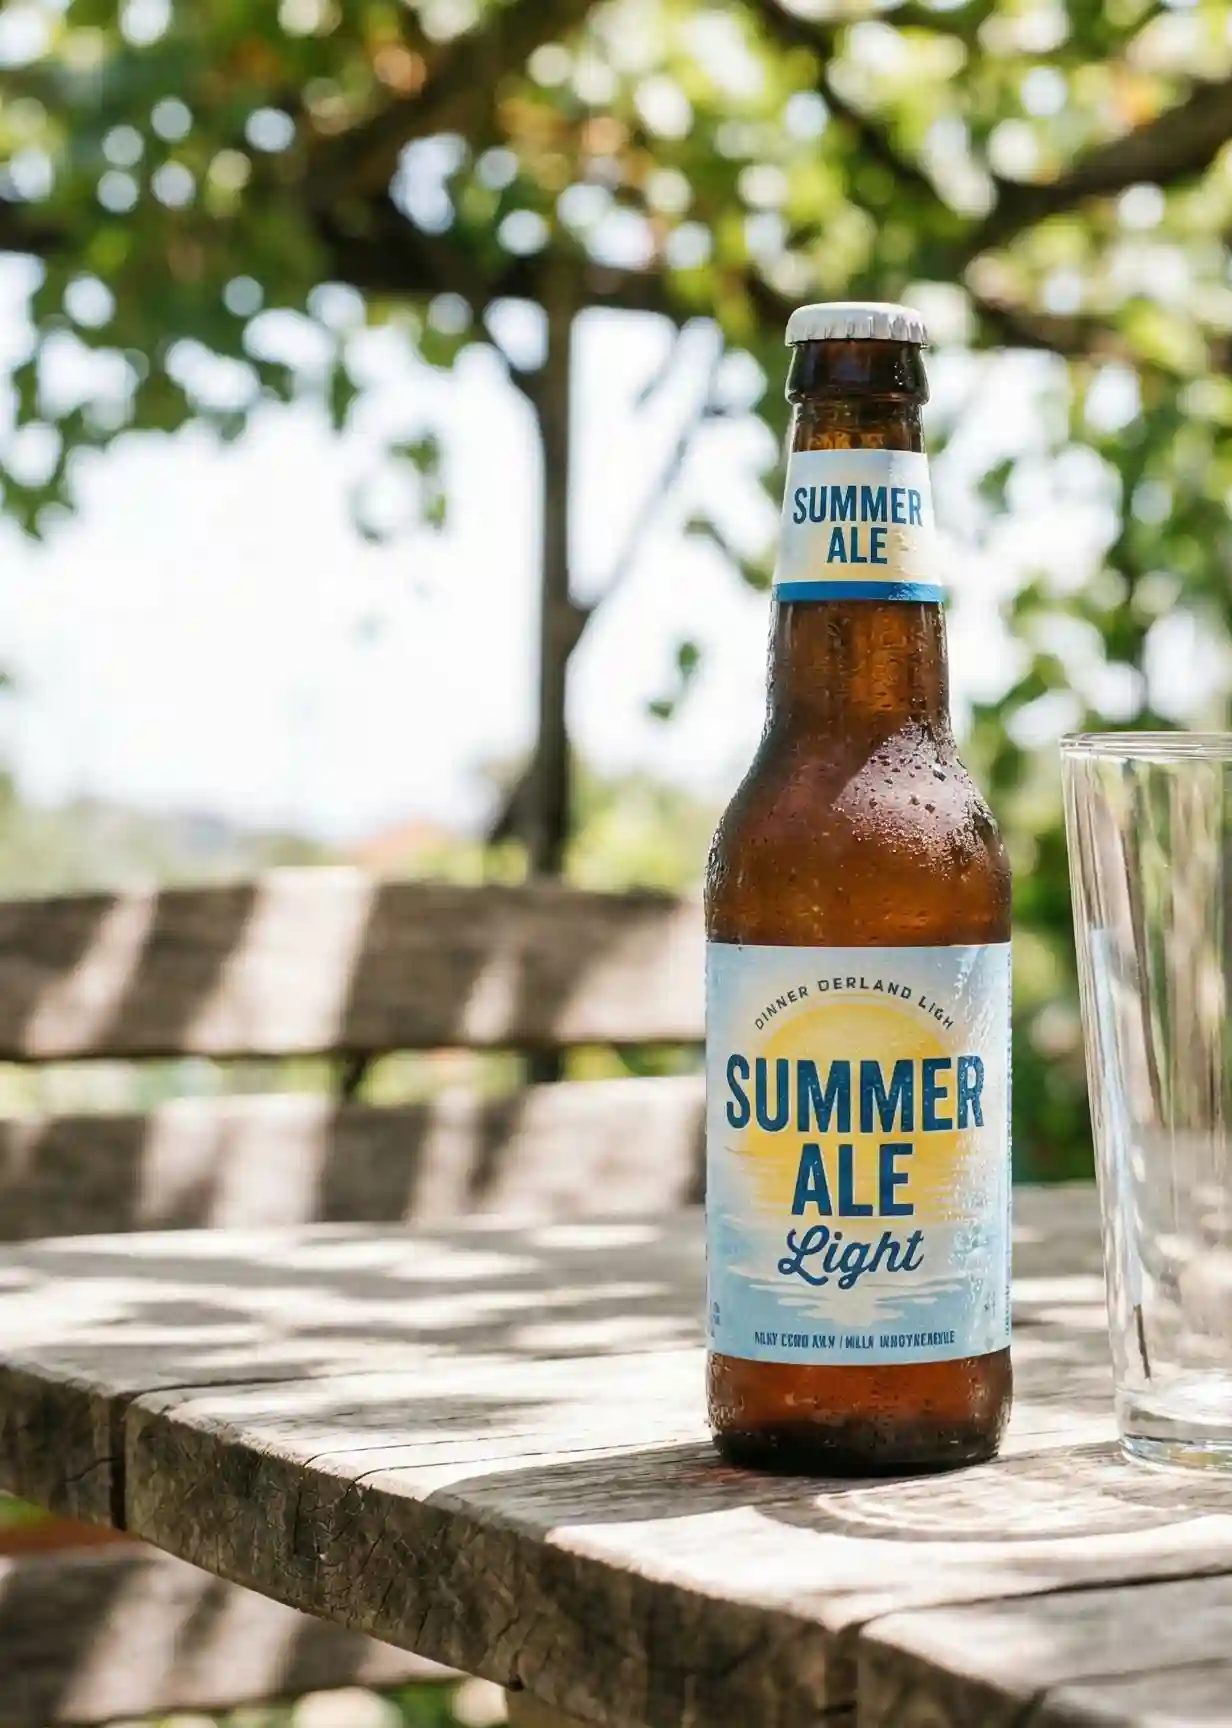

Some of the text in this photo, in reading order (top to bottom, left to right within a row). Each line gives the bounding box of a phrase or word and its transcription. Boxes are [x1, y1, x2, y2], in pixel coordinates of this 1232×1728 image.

[793, 485, 923, 527] SUMMER
[826, 526, 888, 564] ALE
[755, 976, 953, 1031] DINNER DERLAND LIGH
[726, 1054, 985, 1133] SUMMER
[791, 1143, 914, 1217] ALE
[777, 1224, 924, 1290] Light
